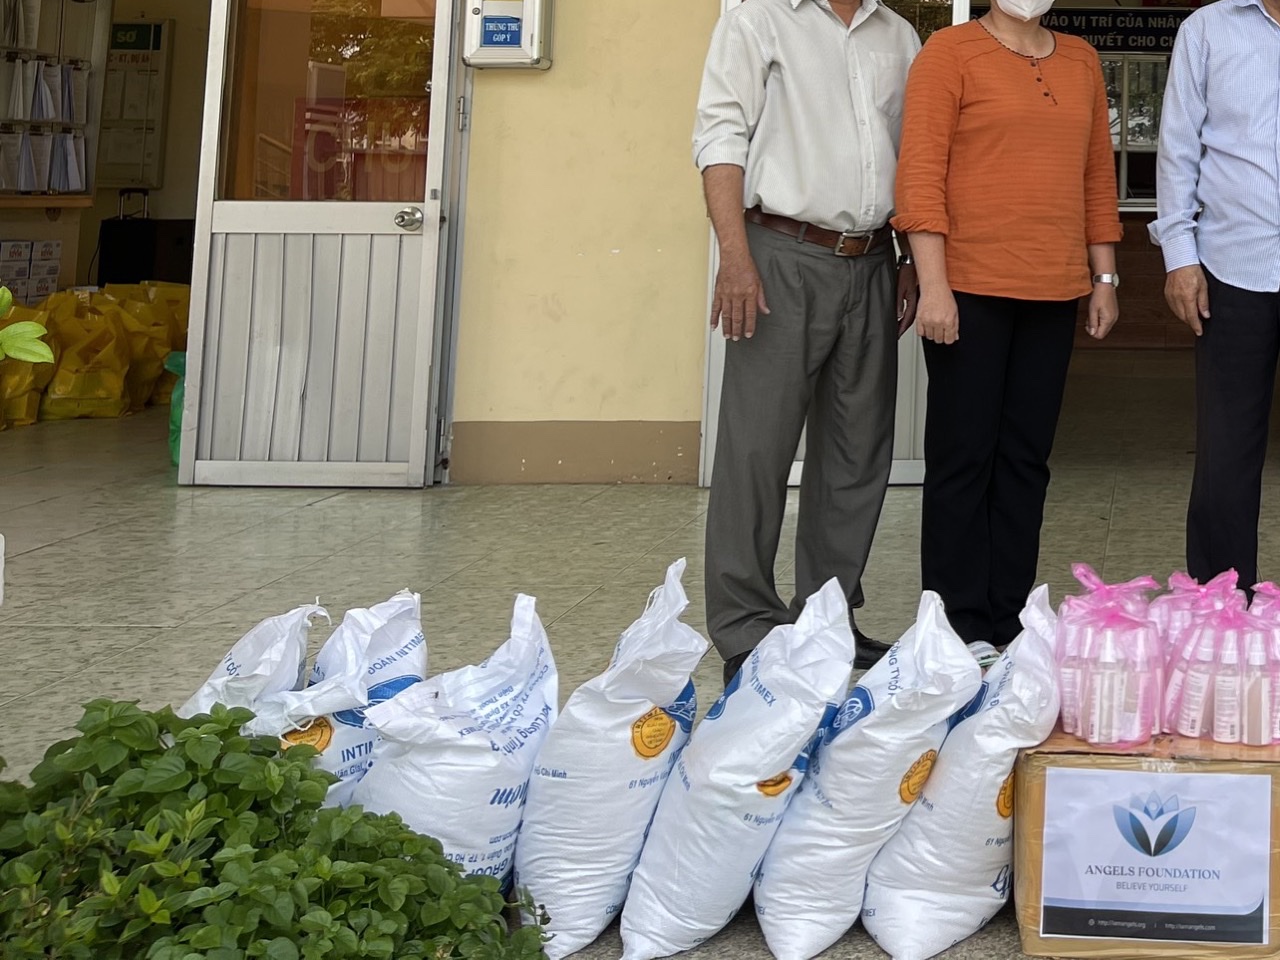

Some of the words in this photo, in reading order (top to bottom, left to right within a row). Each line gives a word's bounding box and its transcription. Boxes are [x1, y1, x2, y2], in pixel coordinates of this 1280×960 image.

[1042, 13, 1069, 27] VÀO
[1073, 16, 1086, 29] VỊ
[1090, 14, 1113, 28] TRÍ
[1116, 13, 1144, 28] CỦA
[1128, 36, 1156, 47] CHO
[395, 632, 425, 658] INTIME
[341, 741, 374, 763] INTI
[1084, 864, 1135, 877] ANGELS
[1137, 866, 1221, 880] FOUNDATION
[1116, 881, 1147, 891] BELIEVE
[1148, 883, 1188, 893] YOURSELF
